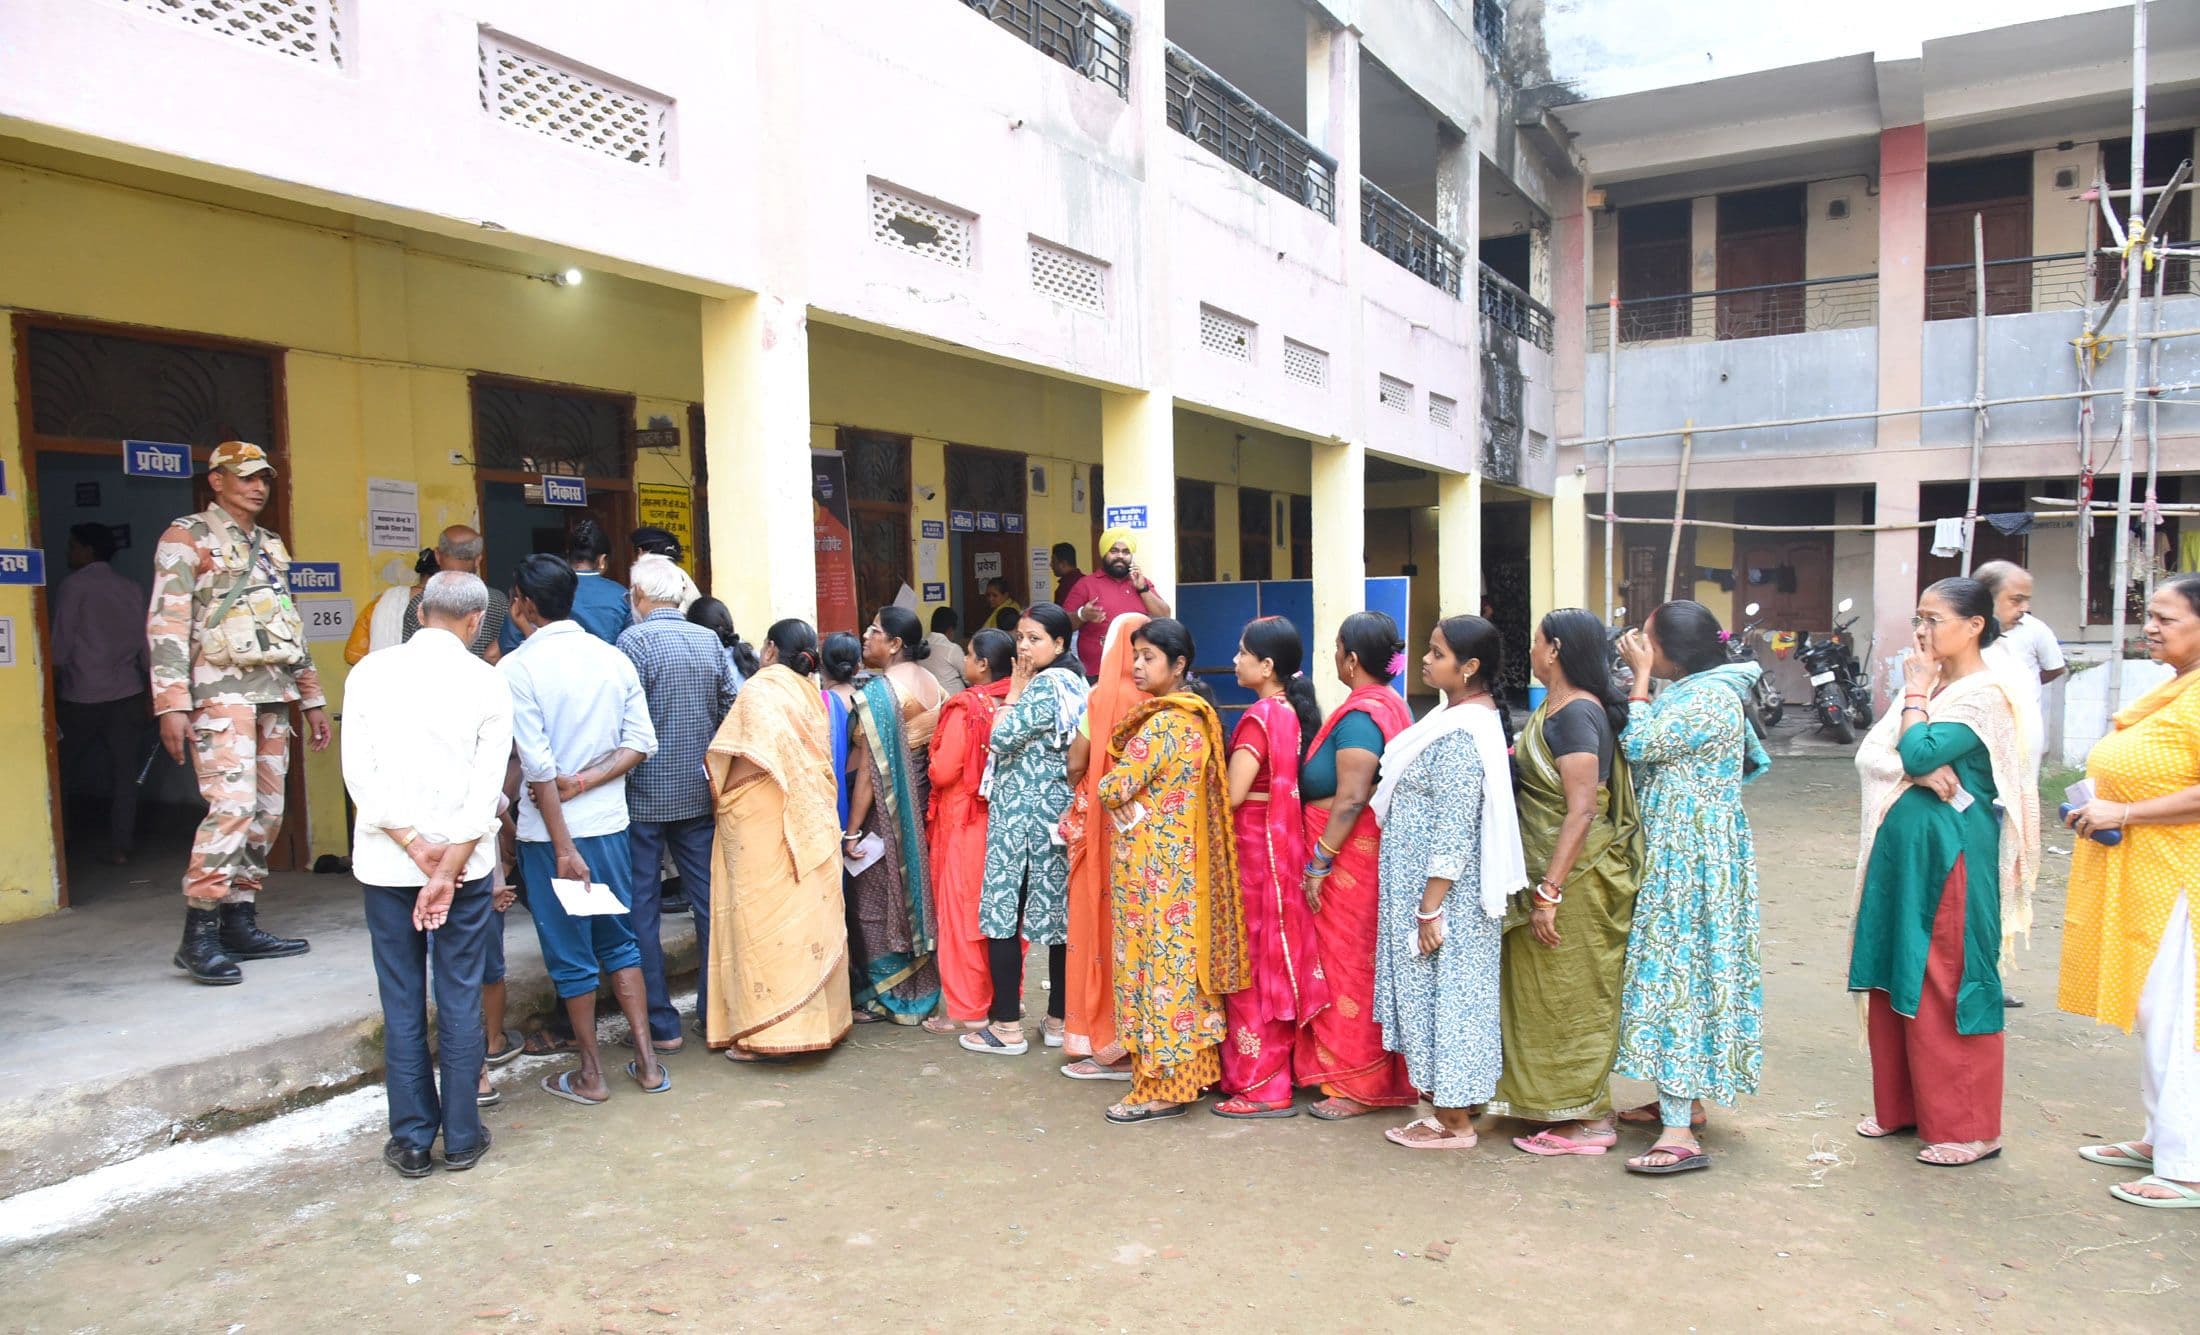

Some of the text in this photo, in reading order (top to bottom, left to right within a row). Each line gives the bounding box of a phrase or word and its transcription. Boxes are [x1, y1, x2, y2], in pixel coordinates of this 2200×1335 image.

[136, 446, 182, 472] प्रवेश
[547, 480, 581, 501] निकास
[977, 558, 997, 571] प्रवेश
[289, 567, 336, 587] महिला
[313, 611, 342, 626] 286
